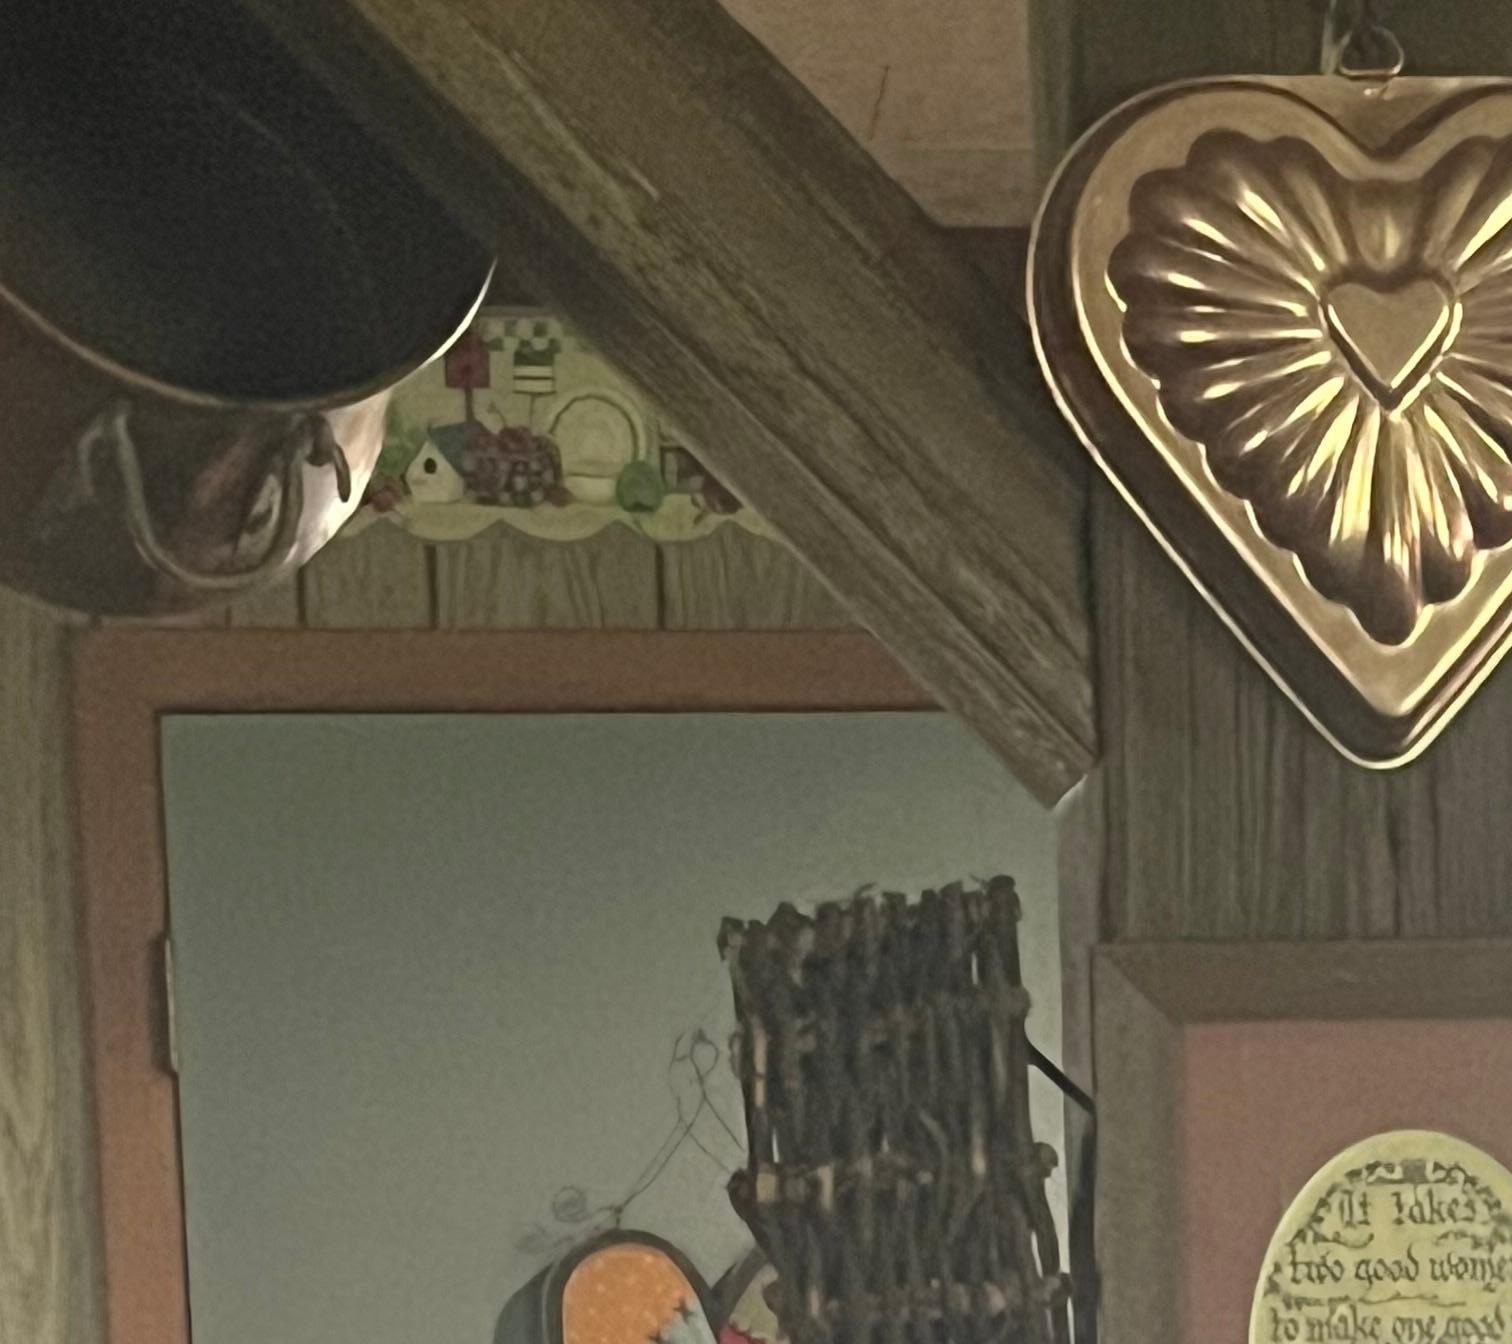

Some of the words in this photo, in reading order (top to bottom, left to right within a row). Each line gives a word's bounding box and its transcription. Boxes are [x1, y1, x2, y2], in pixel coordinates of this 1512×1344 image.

[1287, 1243, 1345, 1285] two
[1354, 1242, 1419, 1290] good
[1269, 1306, 1300, 1343] to
